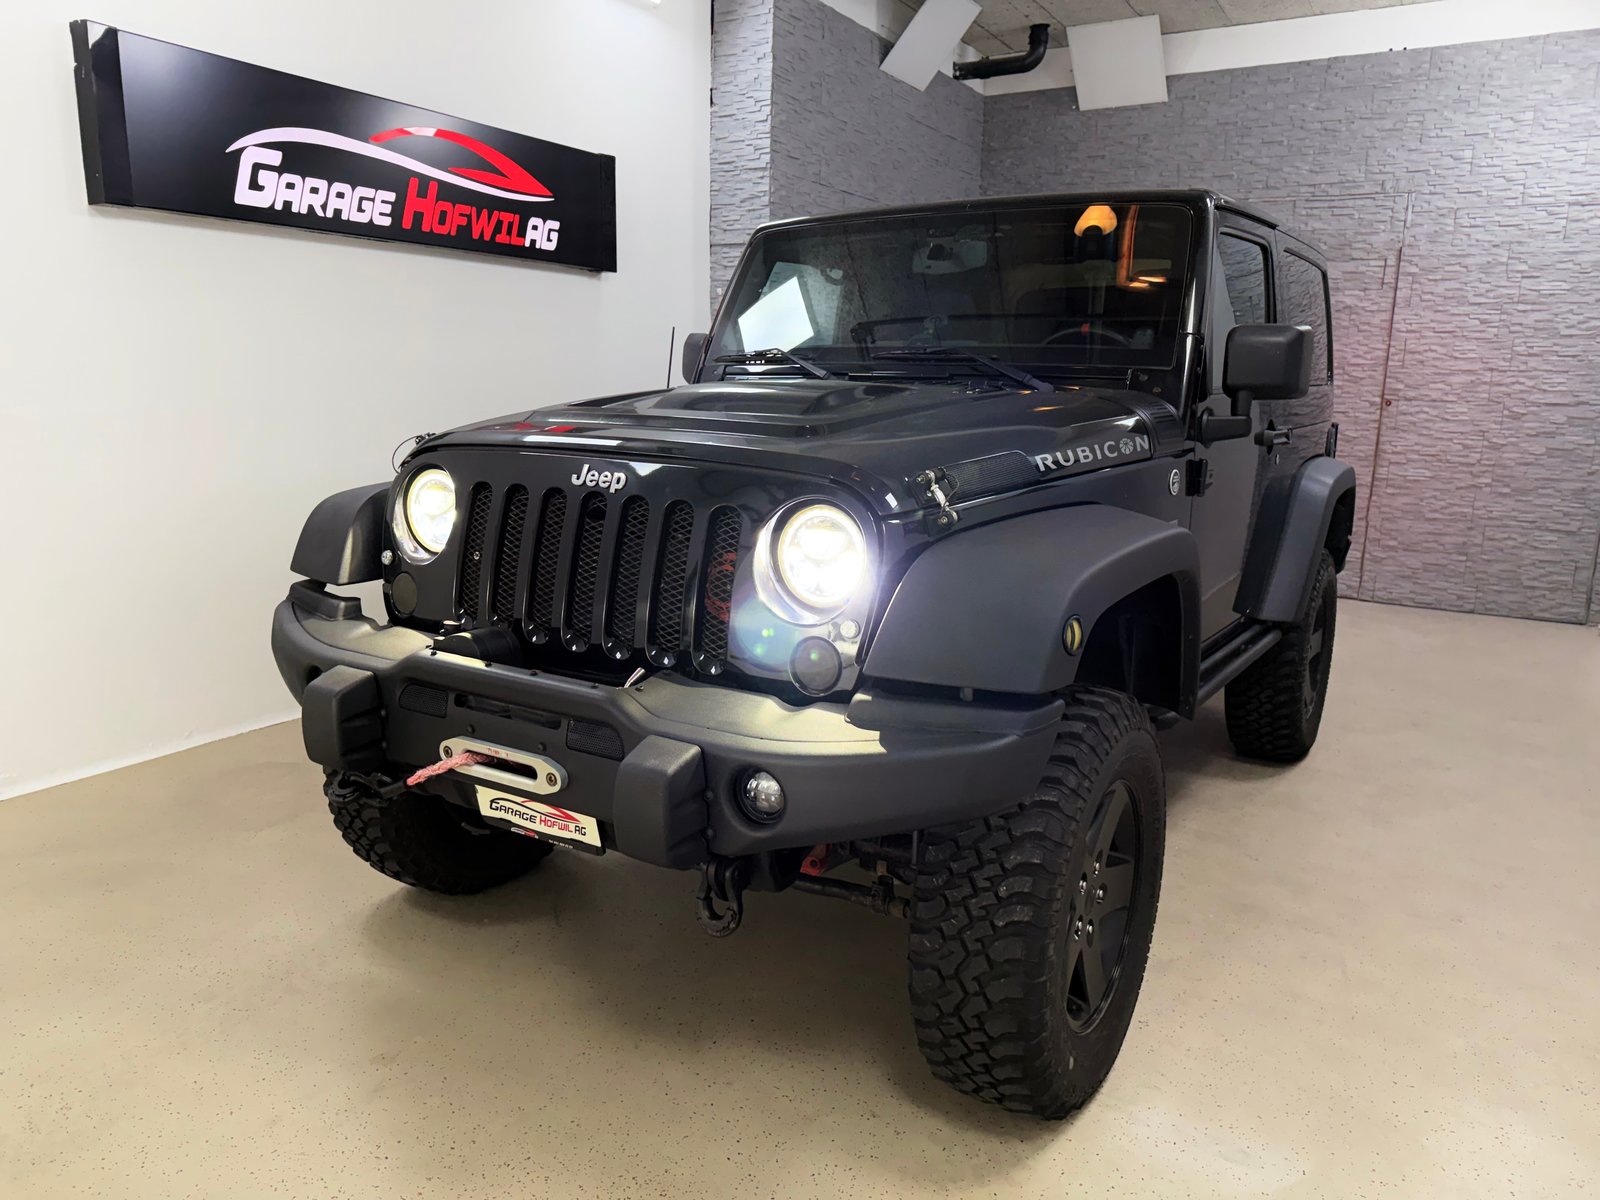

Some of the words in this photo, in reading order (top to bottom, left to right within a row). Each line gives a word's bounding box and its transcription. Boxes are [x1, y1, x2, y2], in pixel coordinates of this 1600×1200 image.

[234, 146, 397, 227] GARAGE
[571, 464, 627, 494] Jeep
[489, 801, 538, 824] GARAGE
[539, 815, 574, 833] HOFWIL
[574, 824, 587, 837] AG
